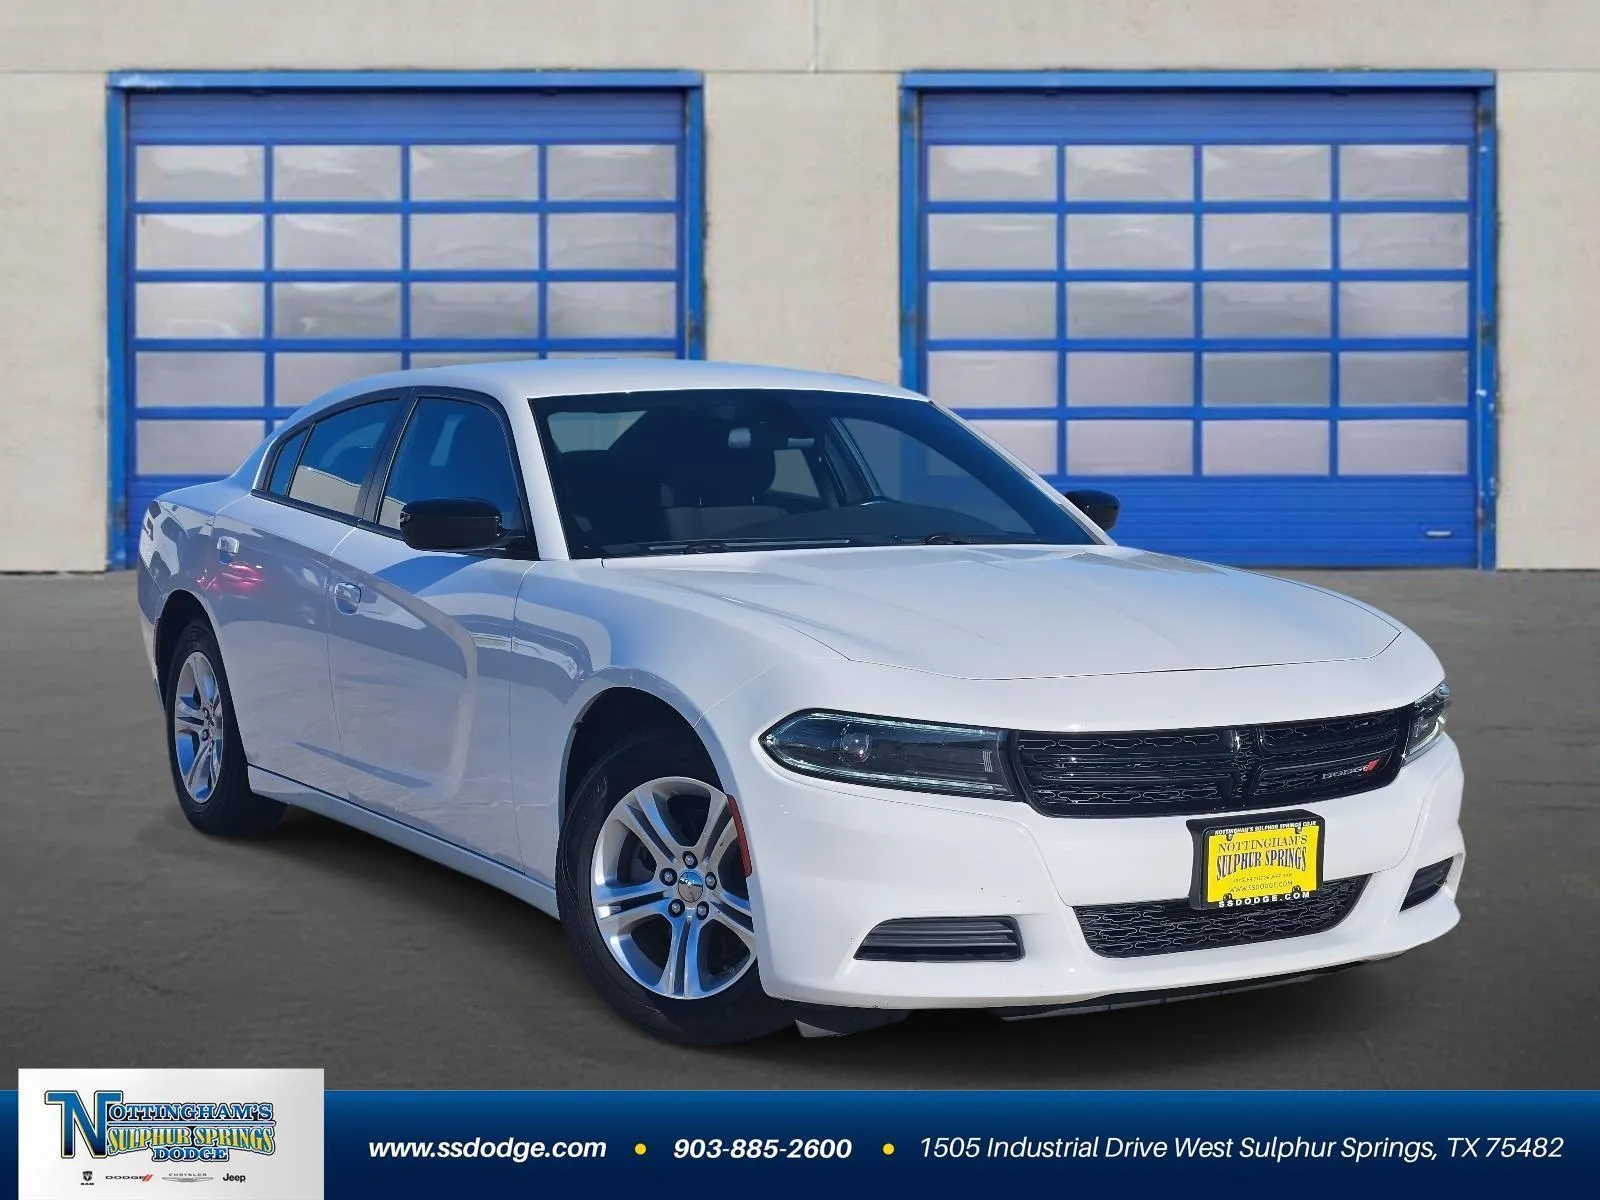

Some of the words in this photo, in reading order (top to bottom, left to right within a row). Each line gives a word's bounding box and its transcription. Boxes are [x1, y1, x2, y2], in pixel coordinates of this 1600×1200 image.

[1218, 834, 1308, 853] NOTTINGHAM'S
[1217, 851, 1262, 881] SULPHUR
[1265, 846, 1307, 872] SPRINGS
[1218, 891, 1310, 908] SSDODGE.COM
